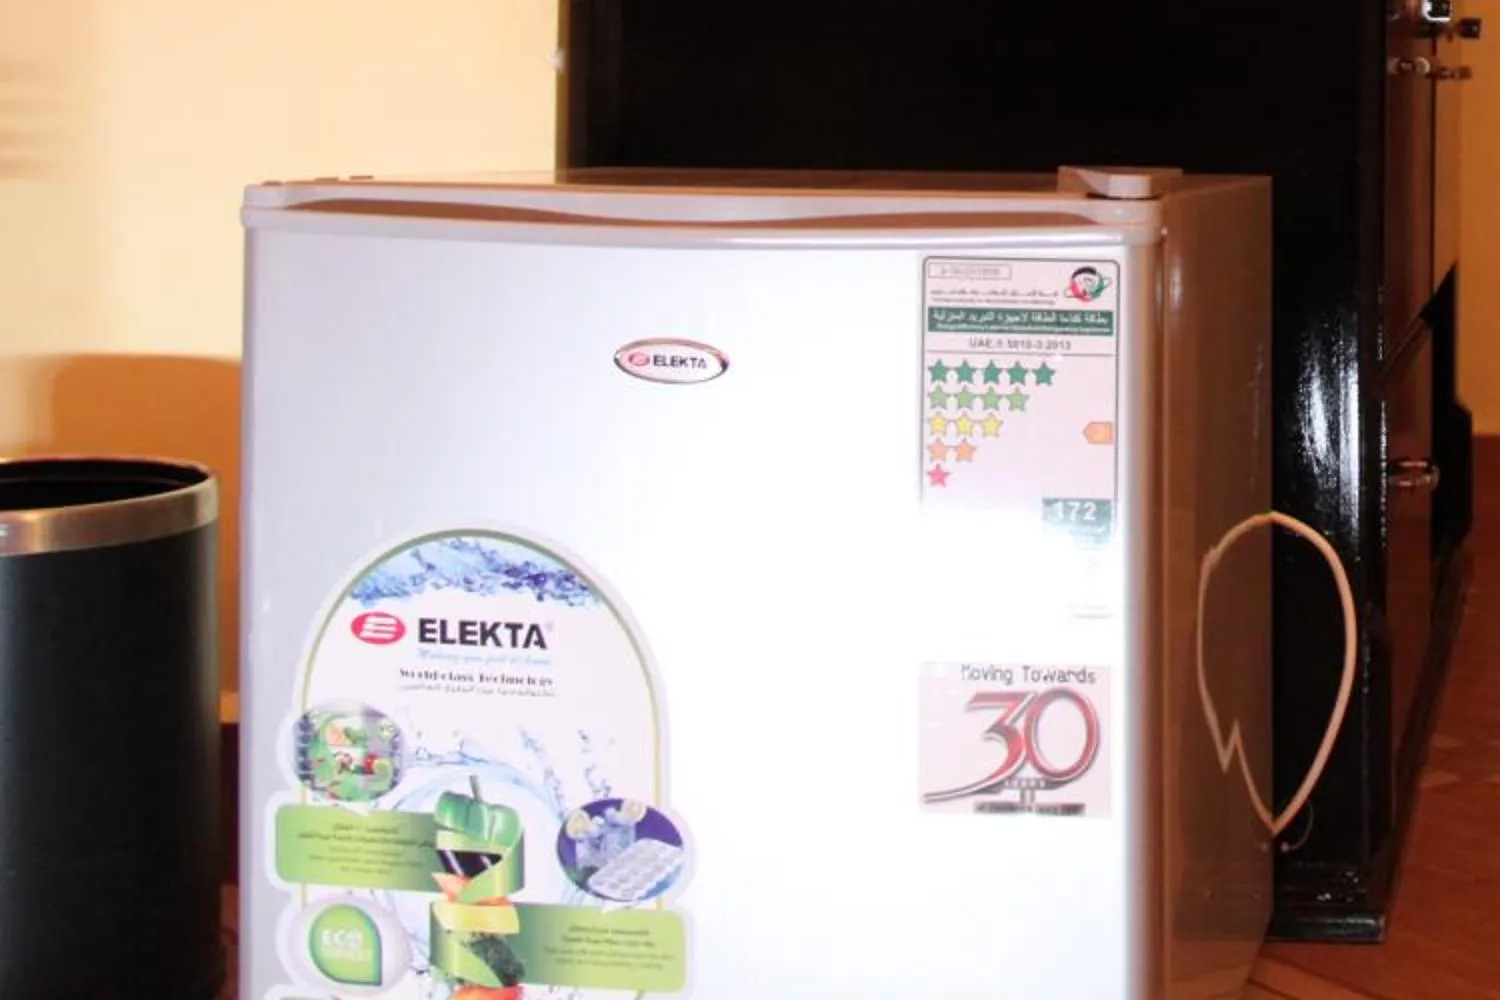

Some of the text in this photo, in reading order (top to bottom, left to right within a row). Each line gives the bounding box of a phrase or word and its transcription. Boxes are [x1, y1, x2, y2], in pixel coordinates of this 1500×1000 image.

[652, 353, 707, 369] ELEKTA
[1053, 500, 1097, 521] 172
[418, 617, 549, 649] ELEKTA
[961, 664, 1097, 686] Moving Towards
